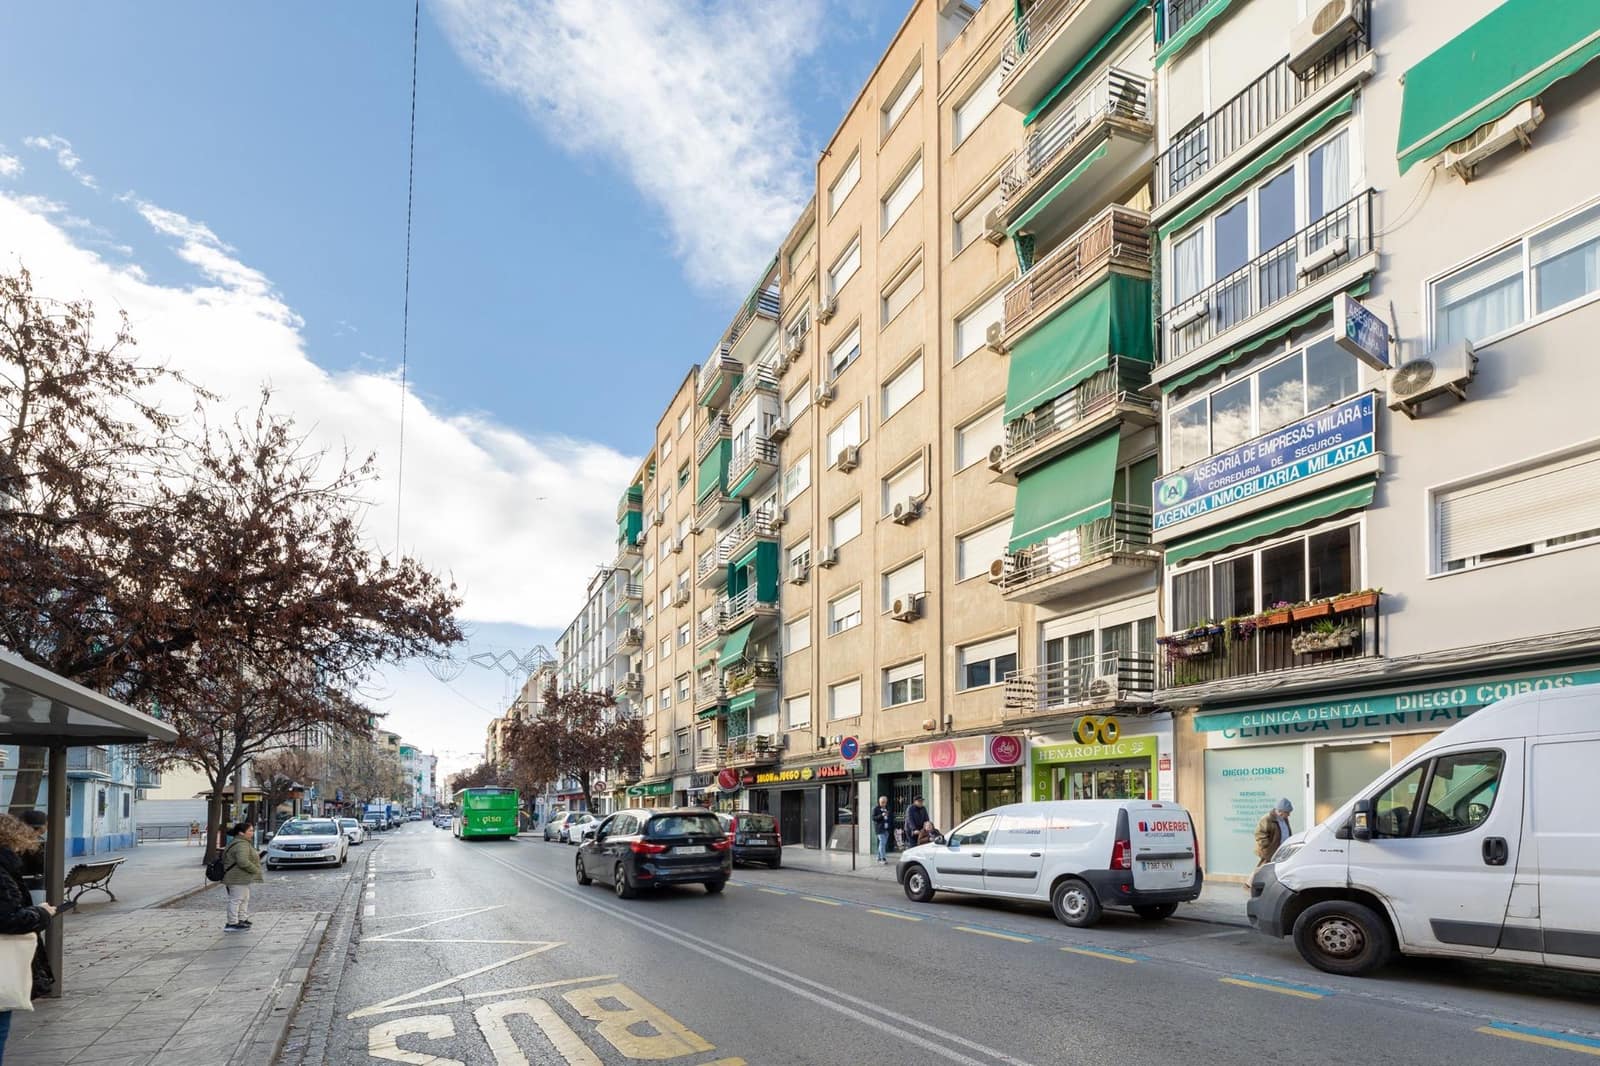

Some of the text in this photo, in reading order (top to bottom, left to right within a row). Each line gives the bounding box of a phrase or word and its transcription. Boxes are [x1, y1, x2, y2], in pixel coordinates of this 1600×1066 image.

[1193, 453, 1241, 483] ASESORIA
[1243, 447, 1256, 463] DE
[1258, 423, 1315, 458] EMPRESAS
[1317, 404, 1362, 435] MILARA
[1208, 433, 1342, 490] CORREDURIA DE SEGUROS
[1157, 441, 1368, 528] AGENCIA INMOBILIARIA MILARA
[1307, 703, 1374, 720] DENTAL
[1395, 688, 1467, 711] DIEGO
[1476, 676, 1575, 702] COBOS
[1039, 744, 1127, 761] HENAROPTIC
[1222, 766, 1285, 777] DIEGO COBOS
[1150, 821, 1189, 832] JOKERBET
[368, 982, 716, 1066] BUS
